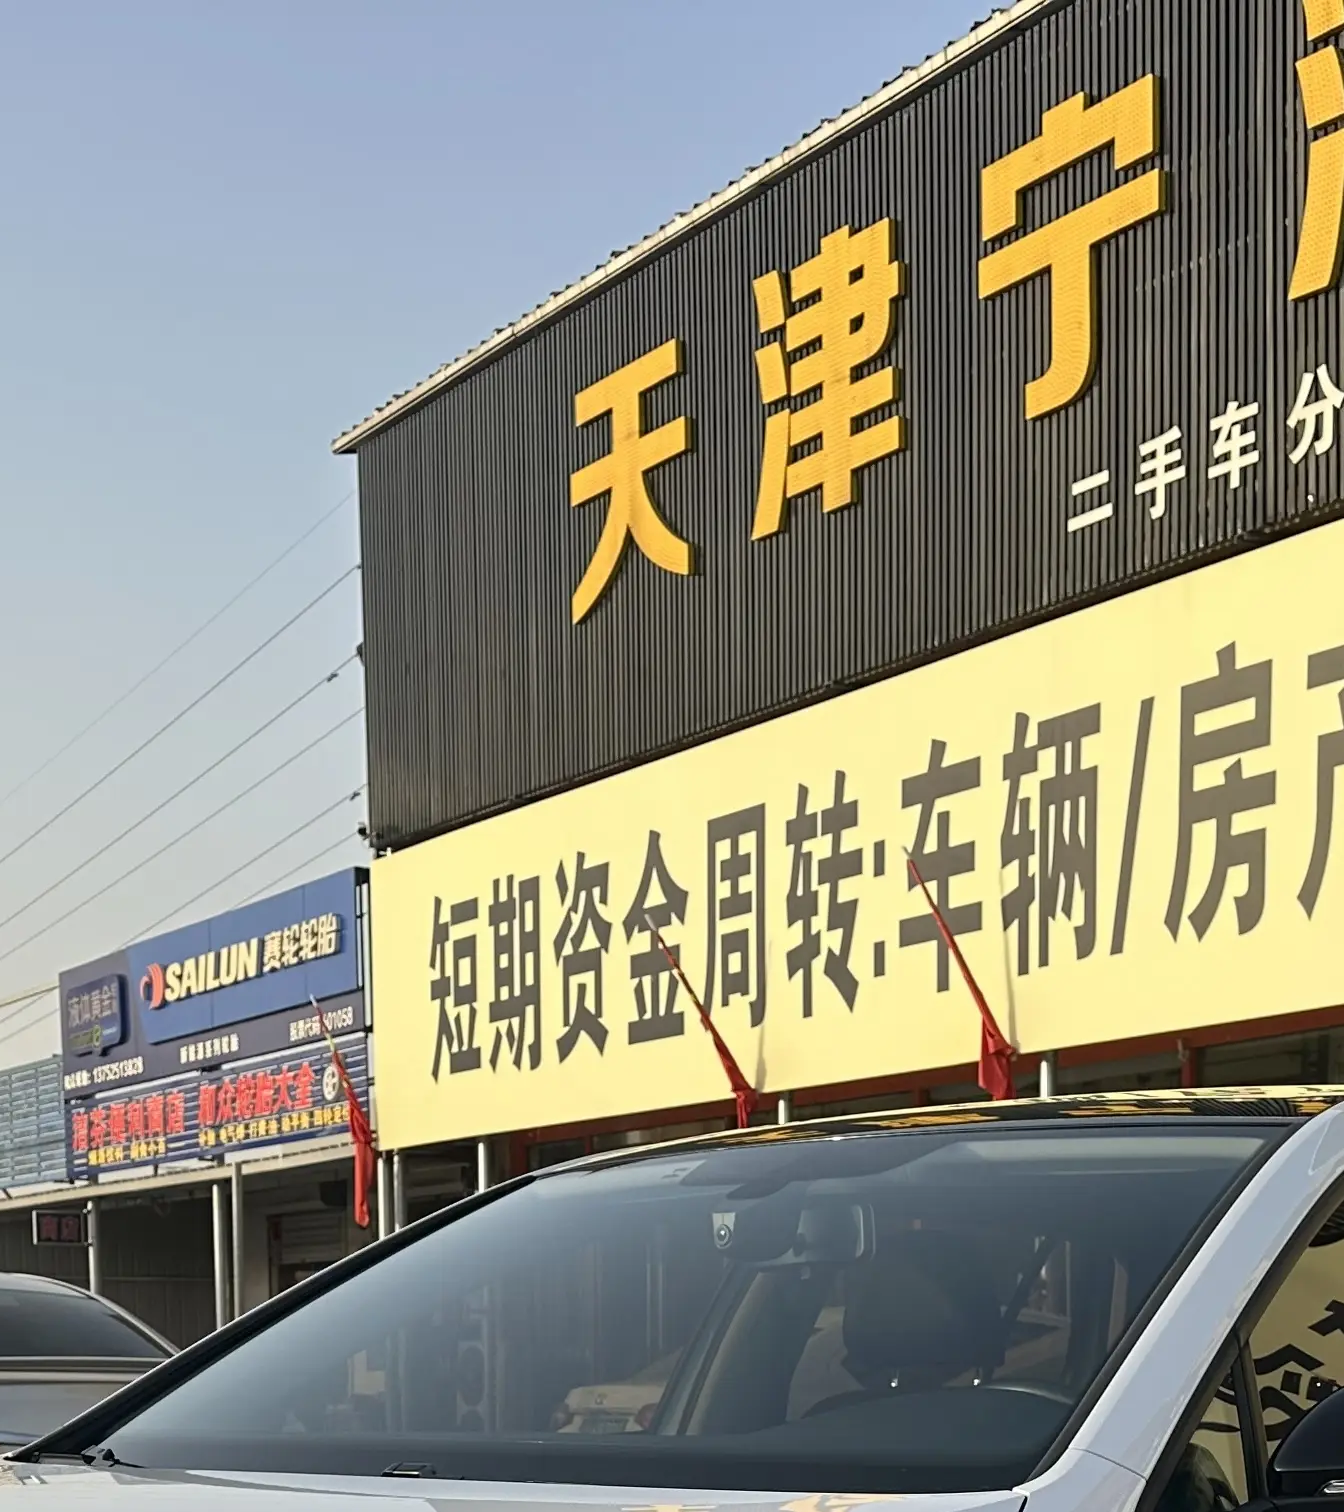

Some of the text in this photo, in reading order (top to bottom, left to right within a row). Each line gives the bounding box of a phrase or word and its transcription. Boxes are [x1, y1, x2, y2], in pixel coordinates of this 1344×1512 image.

[164, 912, 338, 1003] SAILUN 赛轮轮胎
